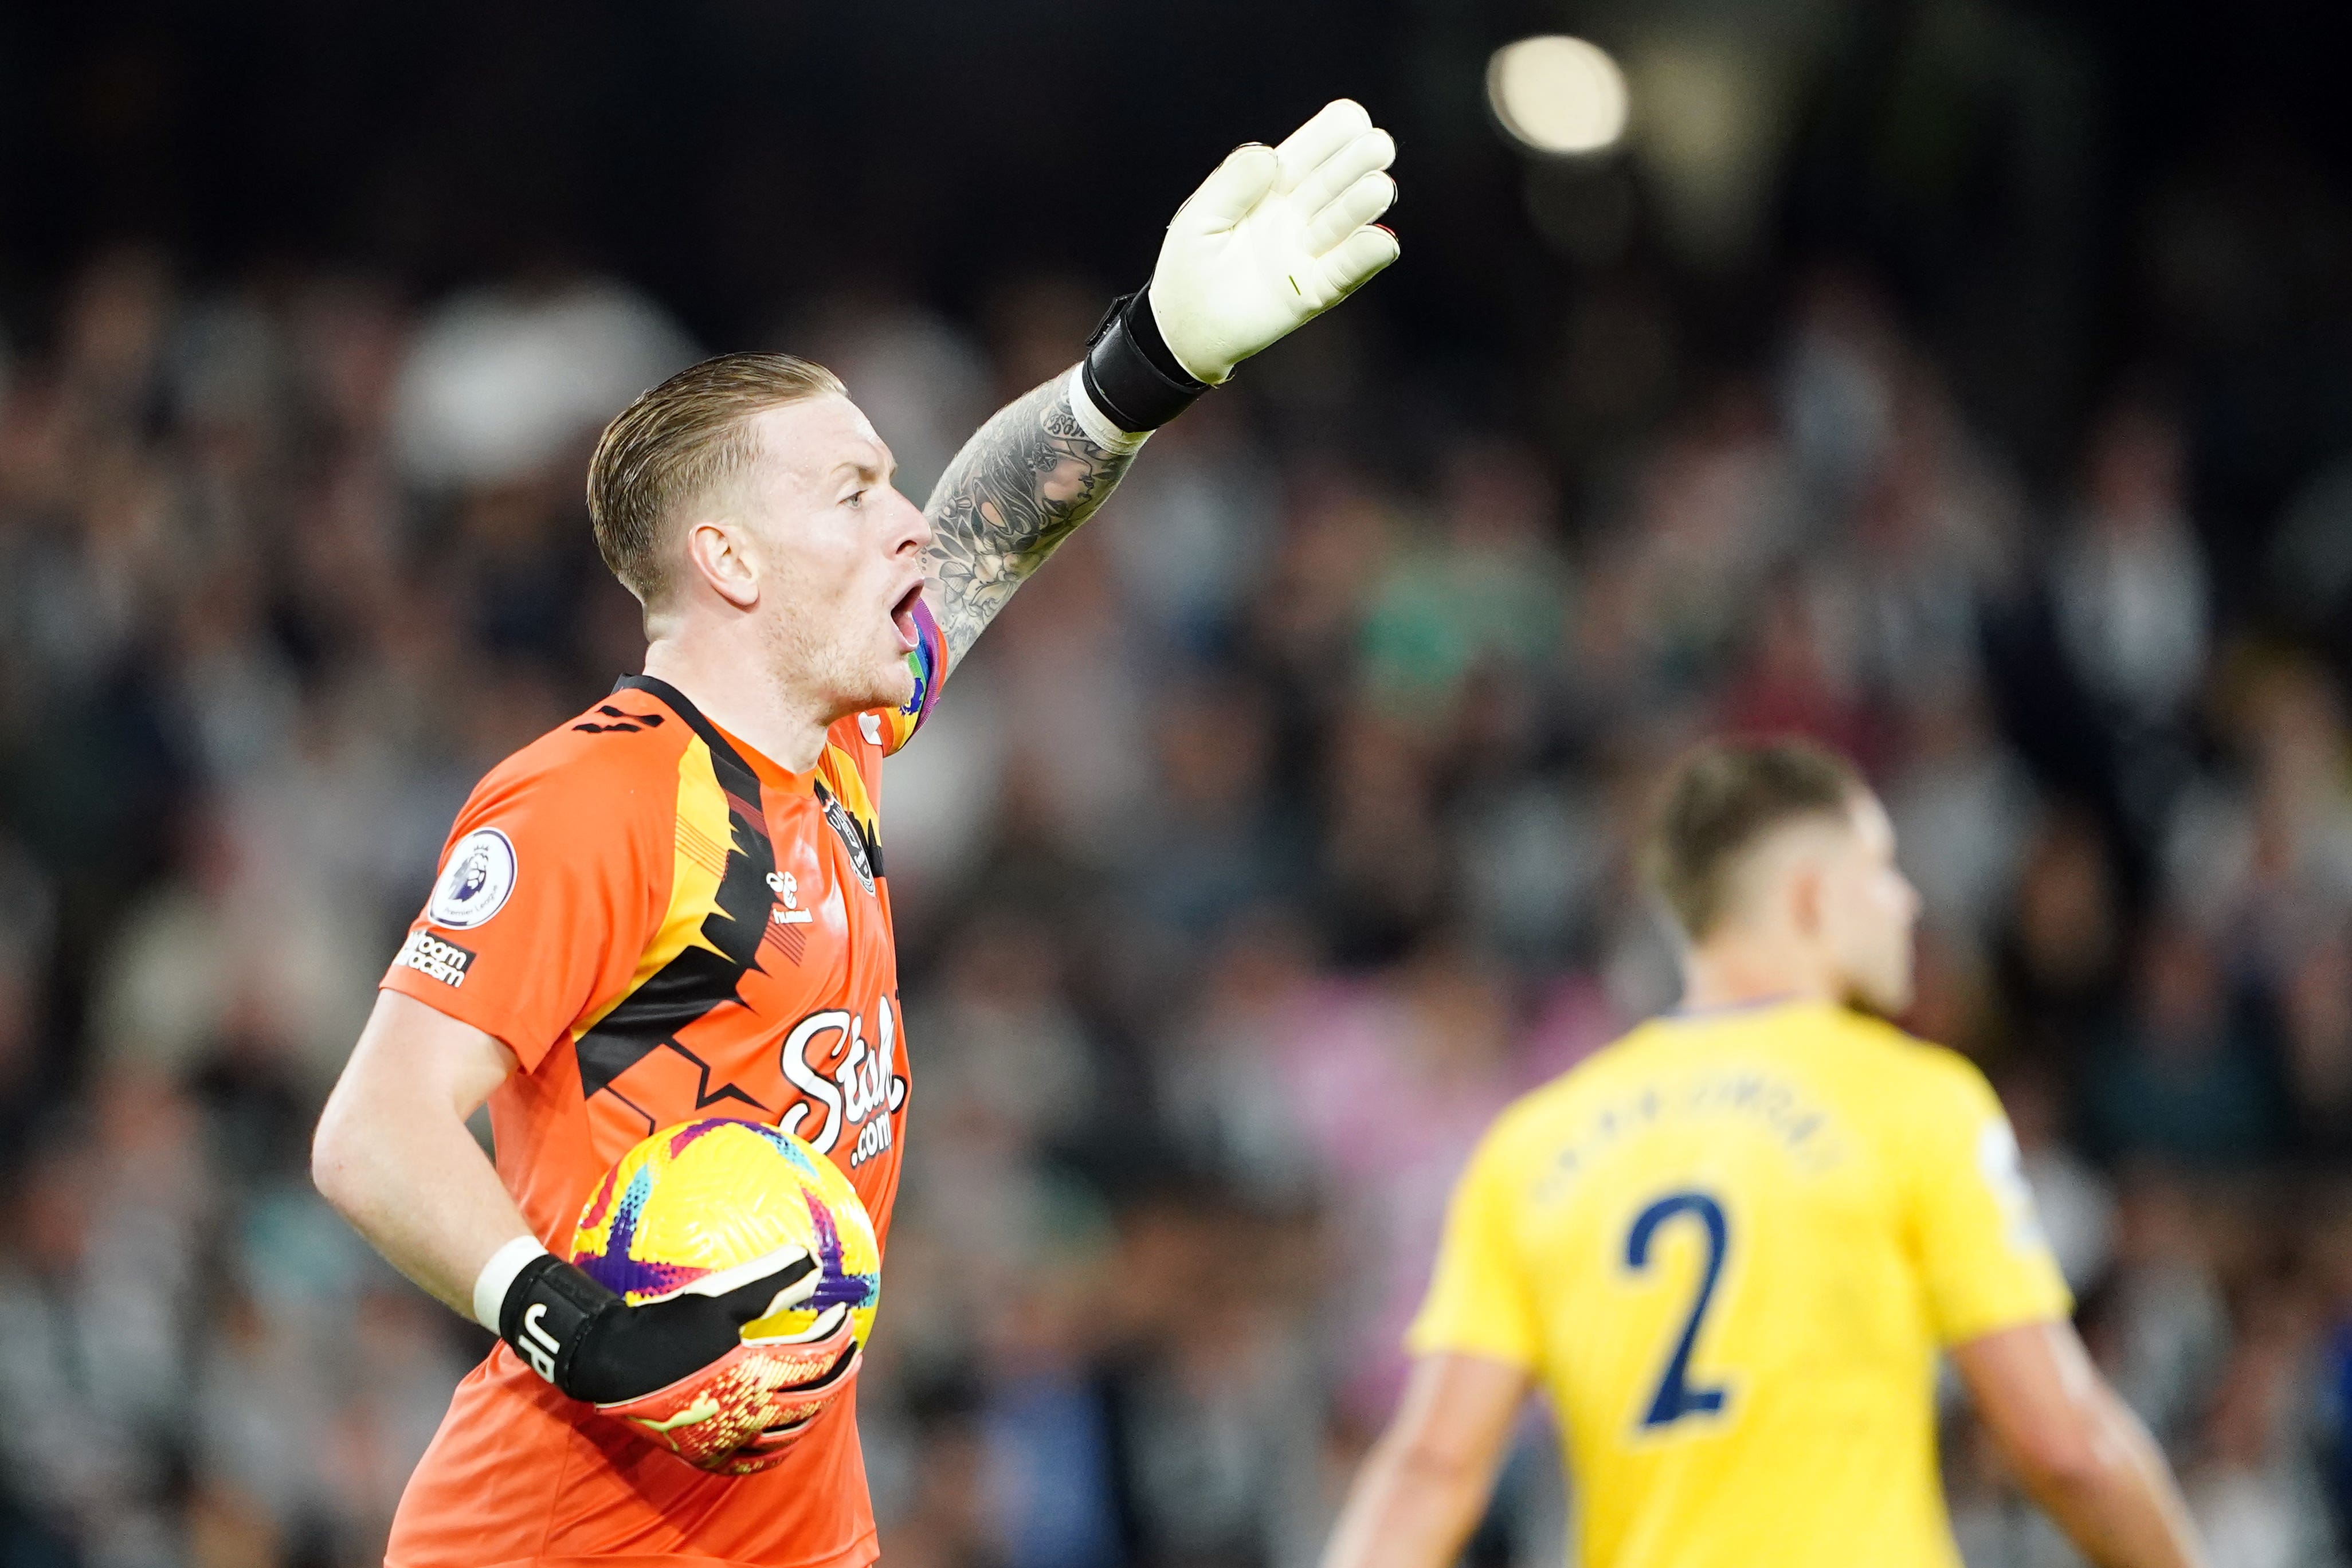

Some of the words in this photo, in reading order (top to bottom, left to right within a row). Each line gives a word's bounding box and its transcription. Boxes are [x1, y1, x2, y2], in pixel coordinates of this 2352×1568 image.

[851, 1111, 893, 1167] .com
[518, 1303, 560, 1384] JP
[1628, 1192, 1727, 1427] 2
